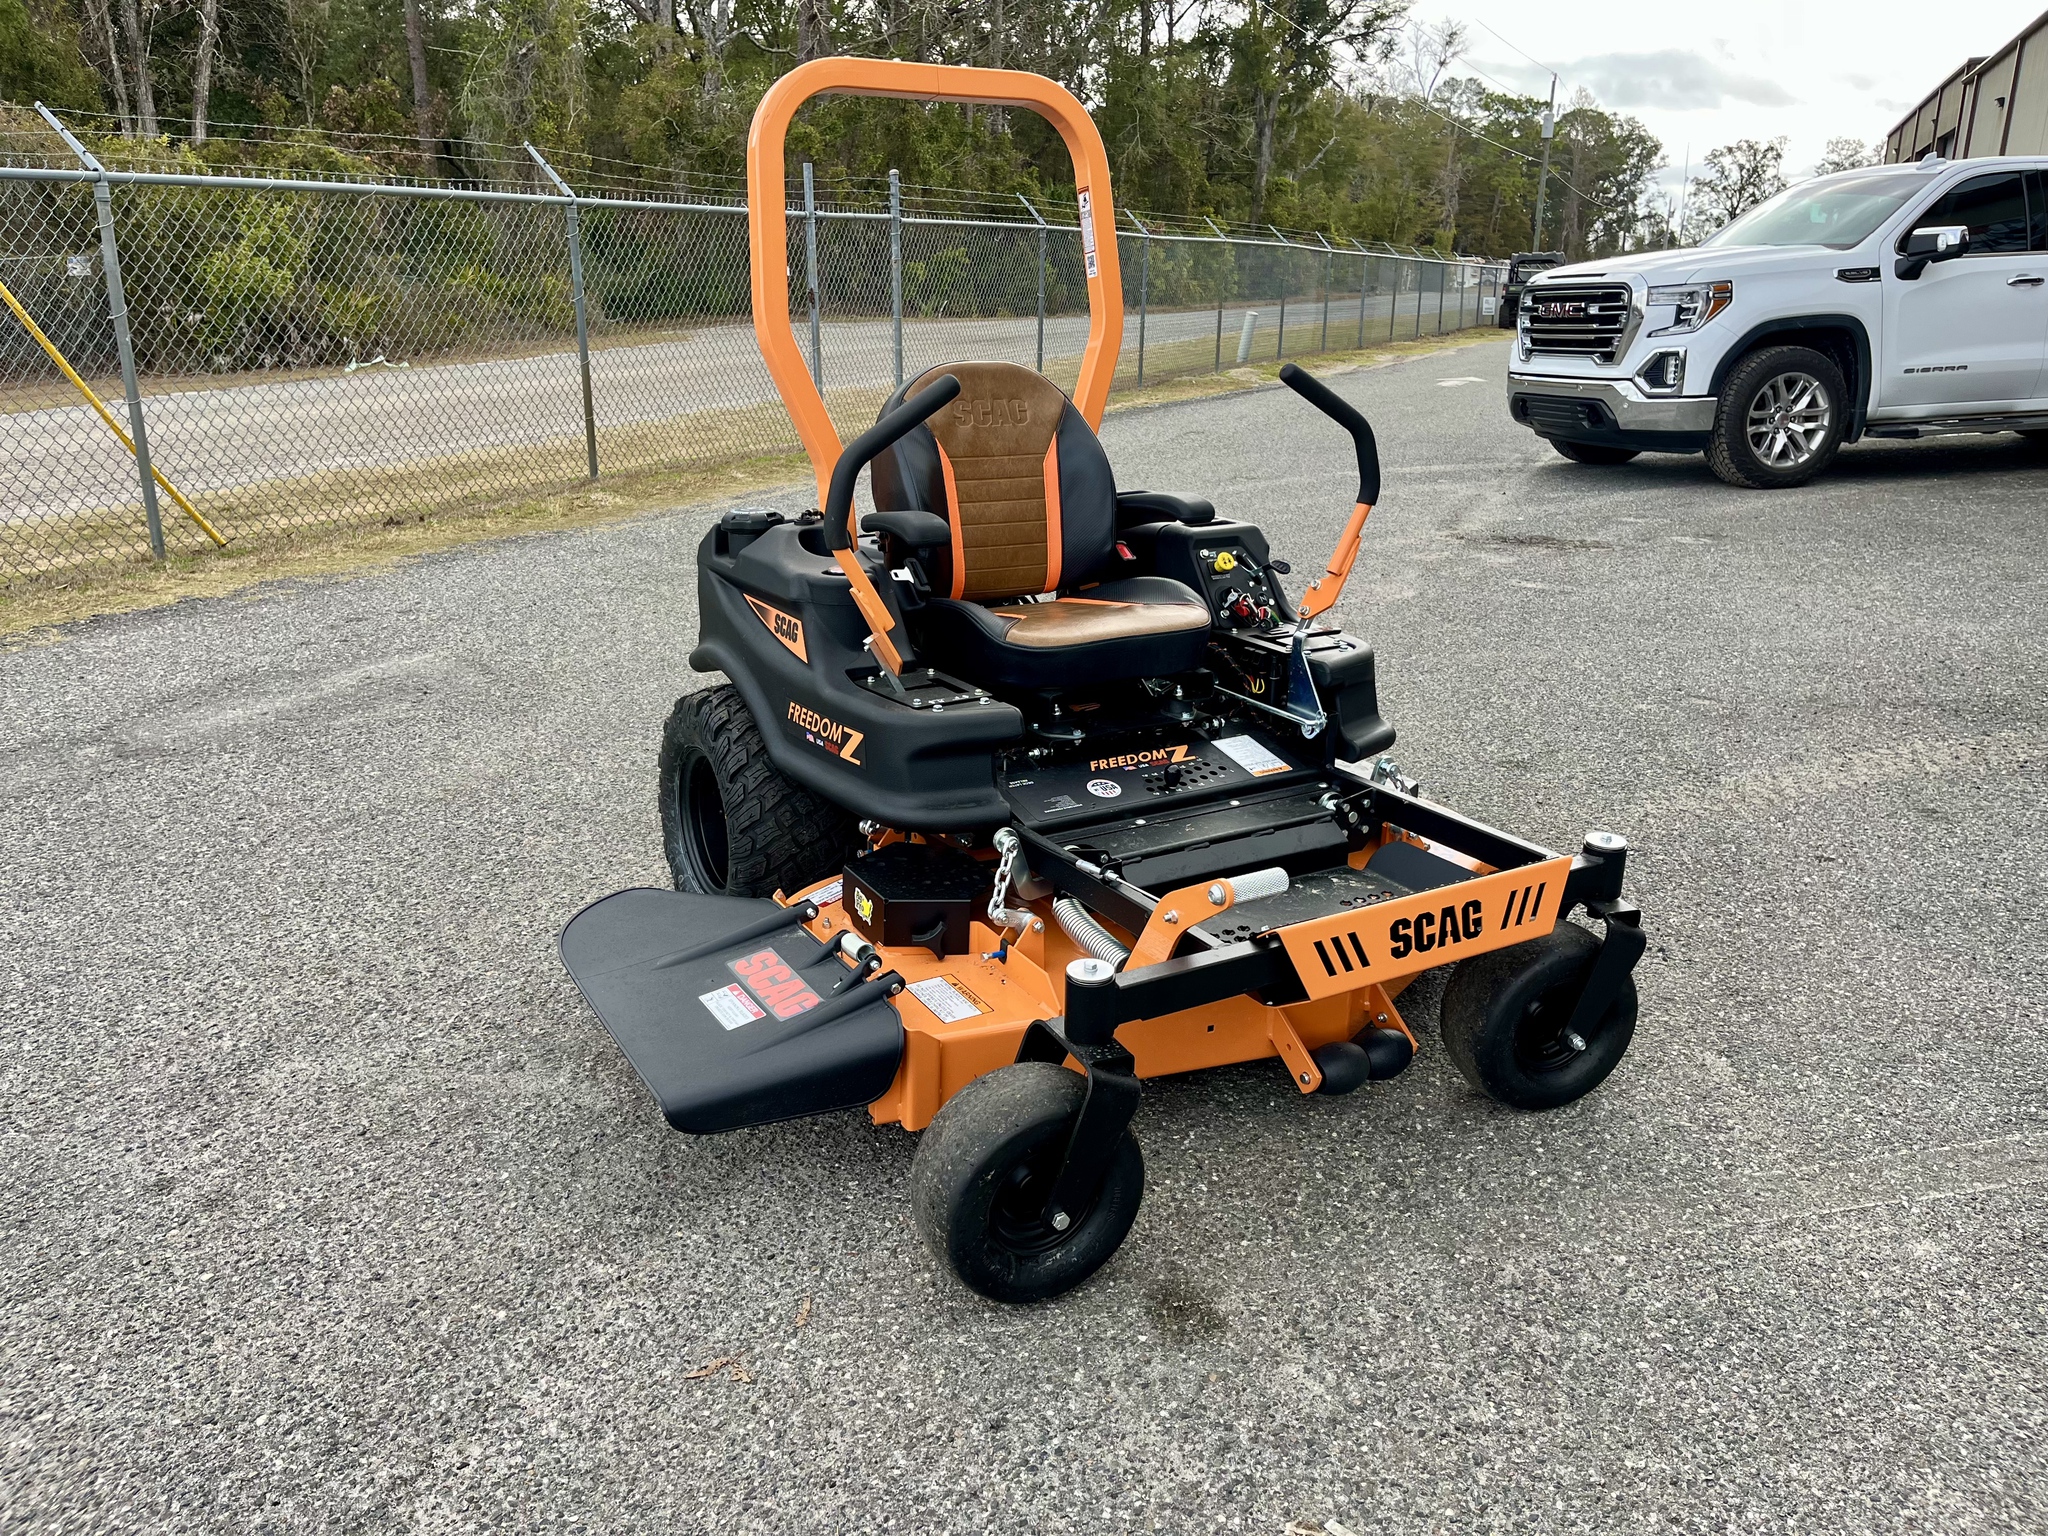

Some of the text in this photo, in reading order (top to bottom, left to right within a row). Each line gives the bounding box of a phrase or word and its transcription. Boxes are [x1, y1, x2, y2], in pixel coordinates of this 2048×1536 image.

[1540, 302, 1585, 318] GMC
[1903, 364, 1968, 374] SIERRA
[952, 398, 1030, 428] SCAG
[774, 613, 799, 643] SCAG
[787, 701, 865, 766] FREEDOM Z
[1090, 744, 1196, 772] FREEDOM Z
[1099, 783, 1118, 792] USA
[1389, 899, 1483, 960] SCAG
[735, 951, 819, 1018] SCAG
[957, 986, 982, 1006] WARNING
[737, 993, 759, 1014] DANGER
